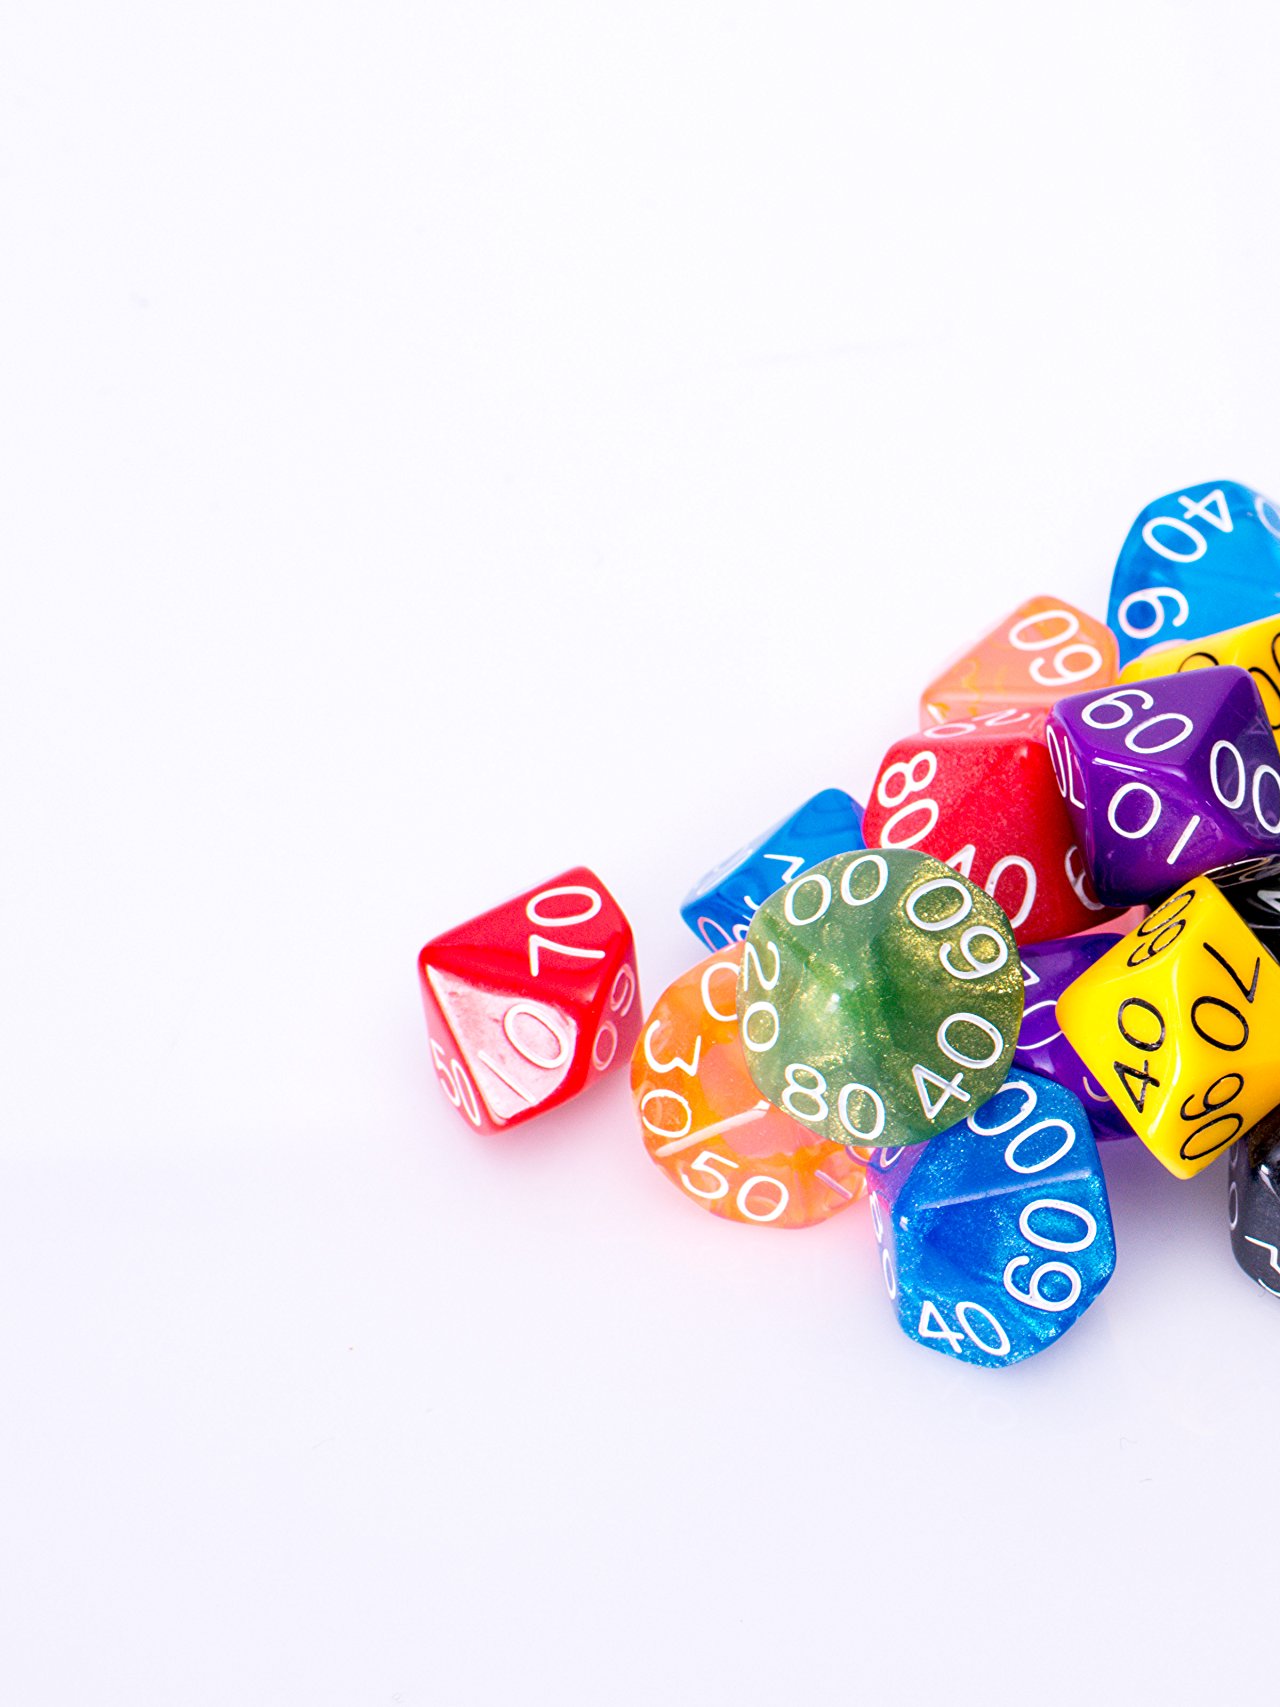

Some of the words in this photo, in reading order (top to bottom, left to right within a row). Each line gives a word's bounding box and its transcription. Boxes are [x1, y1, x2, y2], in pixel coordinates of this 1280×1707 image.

[1142, 489, 1233, 563] 40
[1009, 609, 1103, 686] 60
[1081, 689, 1194, 754] 60
[877, 749, 939, 849] 80
[1107, 782, 1201, 865] 10
[526, 885, 606, 977] 70
[784, 854, 889, 926] 00
[905, 878, 1009, 980] 60
[743, 940, 781, 1052] 20
[1190, 942, 1260, 1052] 70
[430, 1037, 482, 1127] 50
[479, 1003, 569, 1104] 10
[640, 1019, 701, 1139] 30
[911, 1012, 1004, 1119] 40
[1113, 997, 1167, 1113] 40
[781, 1062, 886, 1141] 80
[967, 1080, 1076, 1174] 00
[1179, 1072, 1245, 1161] 90
[680, 1150, 789, 1222] 50
[1002, 1199, 1097, 1313] 60
[918, 1300, 1011, 1356] 40
